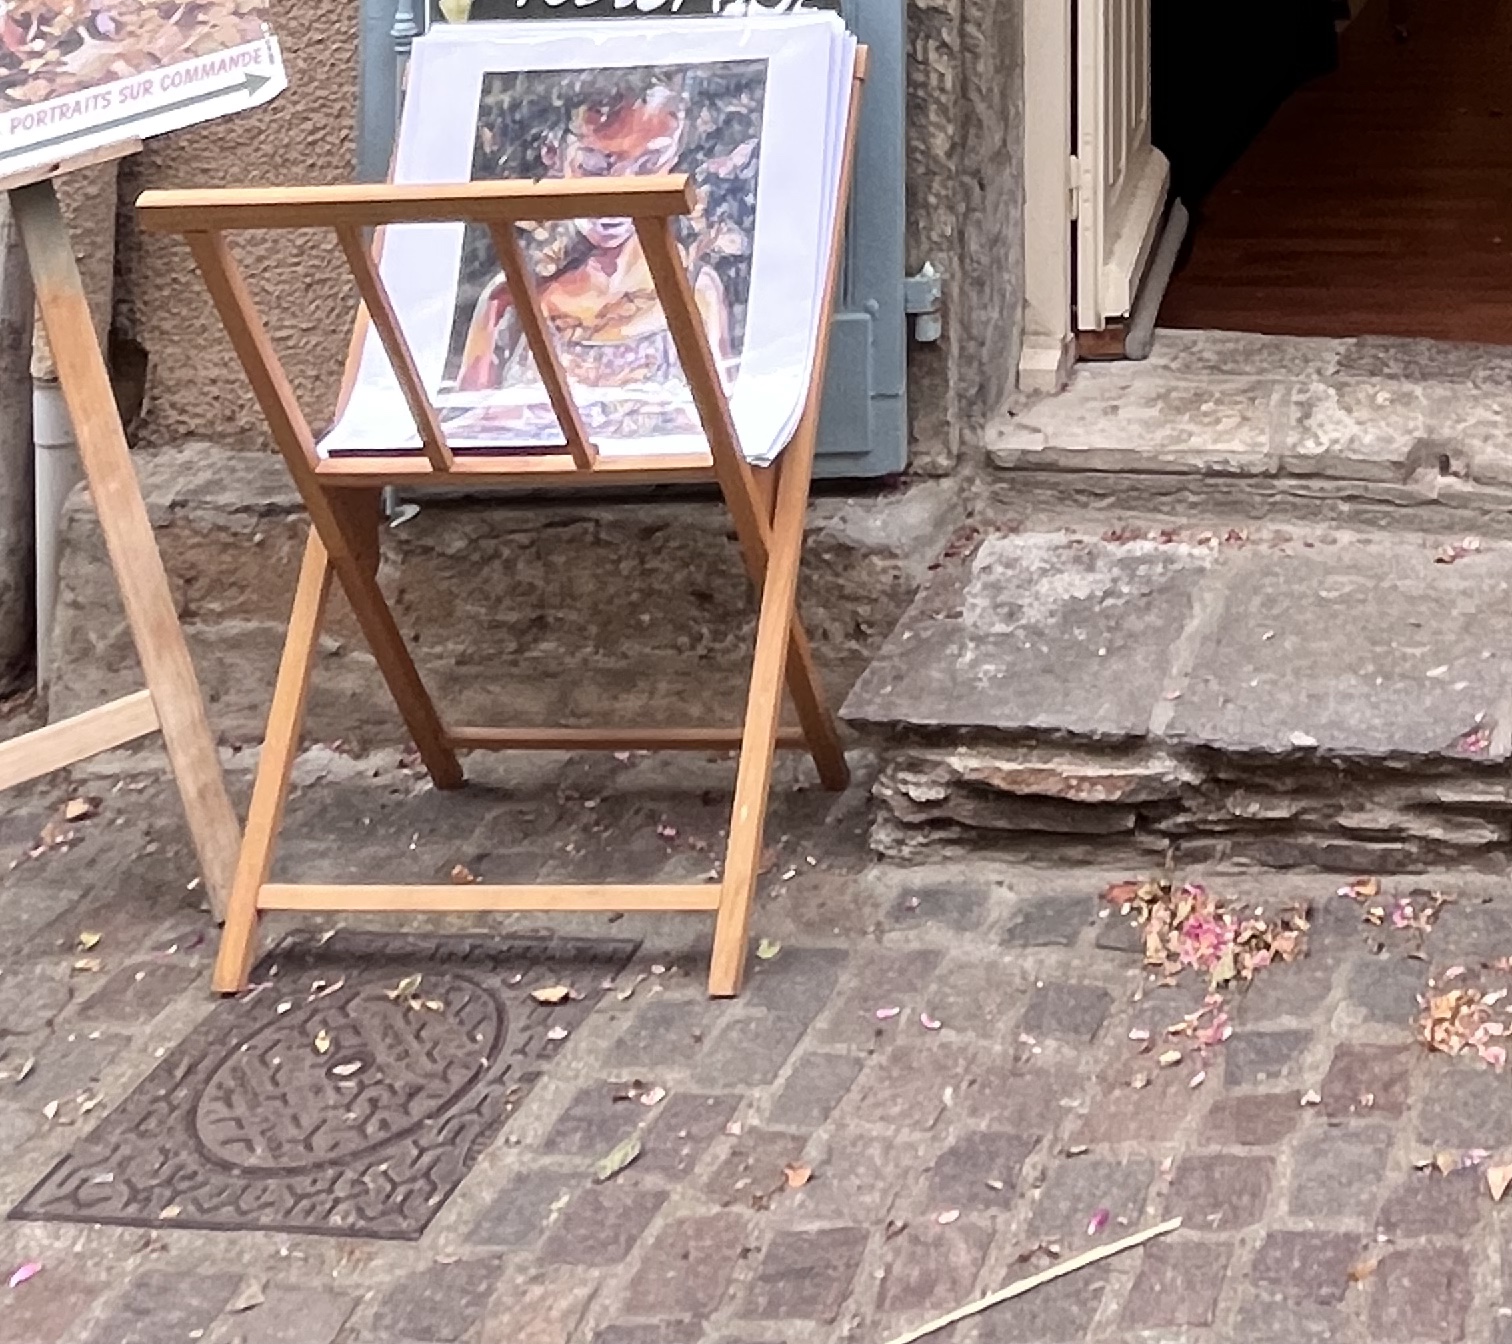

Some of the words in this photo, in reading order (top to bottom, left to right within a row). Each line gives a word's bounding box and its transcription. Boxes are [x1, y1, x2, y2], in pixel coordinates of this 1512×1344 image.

[10, 91, 112, 136] PORTRAITS
[118, 82, 154, 104] SUR
[160, 47, 263, 92] COMMANDE
